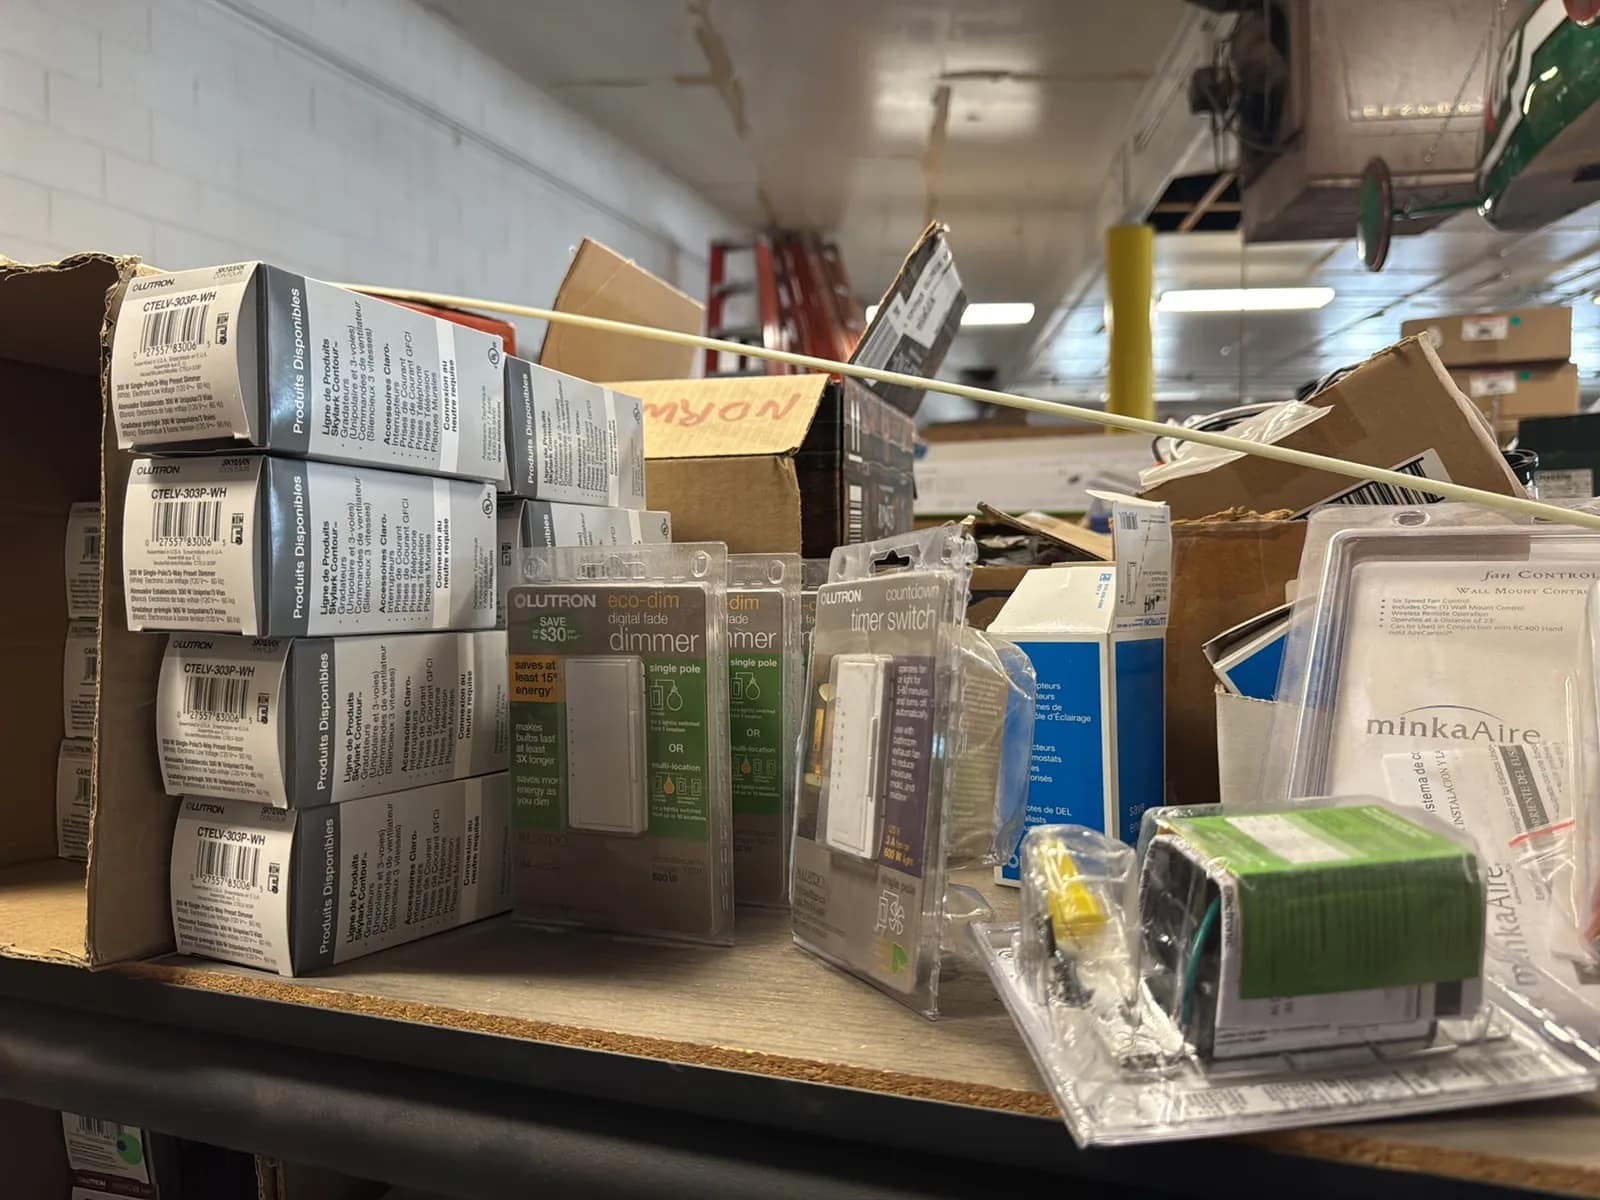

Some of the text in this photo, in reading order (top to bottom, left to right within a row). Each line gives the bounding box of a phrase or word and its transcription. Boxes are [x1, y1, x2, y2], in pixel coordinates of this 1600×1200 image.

[138, 278, 175, 290] LUTRON
[143, 291, 216, 312] CTELV-303P-WH
[146, 341, 197, 357] 27557 83006
[290, 288, 305, 434] Produits Disponibles
[350, 369, 358, 381] et
[353, 301, 367, 441] Commandes de ventilateur
[322, 339, 332, 435] Ligne de Produits
[404, 332, 416, 449] Prises de Courant GFCI
[442, 360, 451, 430] Connexion au
[449, 359, 457, 432] neutre requise
[331, 395, 340, 436] Skylark
[340, 379, 349, 438] Gradateurs
[383, 379, 392, 445] Accessoires
[392, 381, 400, 446] Interrupteurs
[399, 358, 408, 448] Prises de Courant
[430, 373, 439, 452] Plaques Murales
[523, 373, 533, 436] Disponibles
[415, 420, 423, 450] Prises
[423, 421, 431, 451] Prises
[144, 466, 180, 474] LUTRON
[151, 488, 226, 499] CTELV-303P-WH
[159, 538, 212, 546] 27557 83006
[292, 476, 306, 618] Produits Disponibles
[348, 546, 355, 557] et
[353, 477, 363, 614] Commandes de ventilateur
[401, 498, 410, 612] Prises de Courant GFCI
[435, 520, 443, 588] Connexion au
[320, 521, 330, 615] Ligne de Produits
[379, 549, 387, 614] Accessoires
[387, 551, 395, 613] Interrupteurs
[395, 567, 402, 580] de
[424, 534, 432, 611] Plaques Murales
[442, 556, 450, 588] neutre
[1480, 570, 1510, 582] fan
[329, 575, 339, 615] Skylark
[338, 557, 347, 614] Gradateurs
[827, 585, 940, 604] LUTRON countdown
[528, 594, 596, 608] LUTRON
[608, 592, 679, 609] eco-dim
[729, 595, 759, 610] dim
[539, 617, 567, 626] SAVE
[608, 612, 668, 627] digital fade
[851, 603, 936, 632] timer switch
[179, 641, 213, 649] LUTRON
[540, 627, 567, 642] $30
[609, 627, 699, 653] dimmer
[184, 664, 255, 677] CTELV-303P-WH
[515, 661, 556, 670] saves at
[649, 664, 701, 675] single pole
[730, 656, 777, 668] single pole
[515, 672, 539, 682] least
[190, 711, 239, 723] 27557 83006
[380, 698, 387, 710] de
[458, 674, 466, 740] Connexion au
[316, 653, 331, 790] Produits Disponibles
[746, 728, 760, 737] OR
[1367, 717, 1541, 745] minkaAire
[343, 692, 355, 782] Ligne de Produits
[361, 724, 370, 779] Gradateurs
[401, 710, 411, 772] Accessoires
[668, 744, 684, 752] OR
[352, 743, 361, 782] Skylark
[1031, 754, 1062, 763] mostats
[1412, 762, 1424, 775] de
[192, 803, 224, 814] LUTRON
[1043, 806, 1072, 816] de DEL
[197, 827, 265, 845] CTELV-303P-WH
[203, 874, 250, 890] 27557 83006
[319, 819, 335, 954] Produits Disponibles
[346, 854, 359, 943] Ligne de Produits
[1486, 867, 1538, 986] mnkaAire
